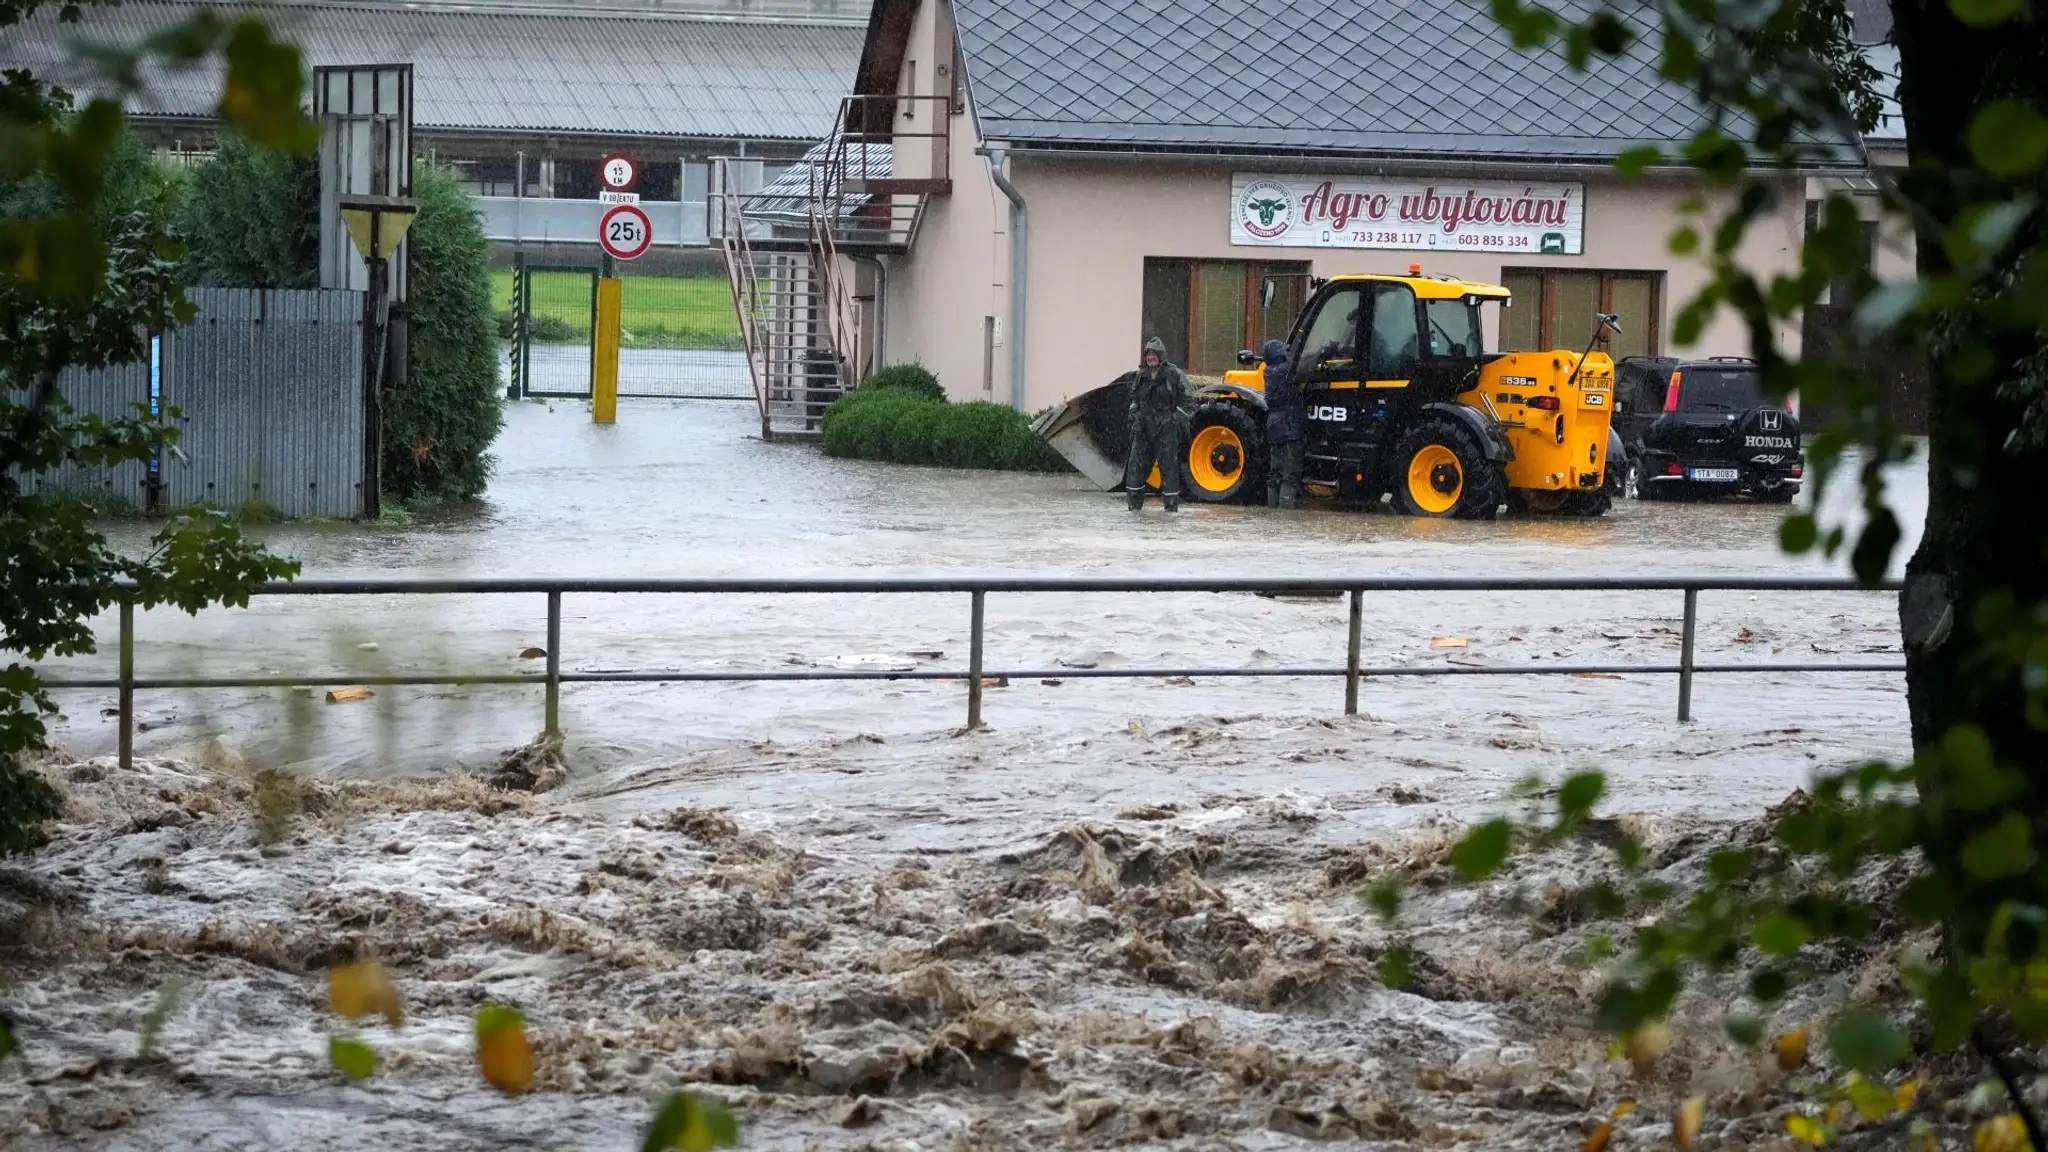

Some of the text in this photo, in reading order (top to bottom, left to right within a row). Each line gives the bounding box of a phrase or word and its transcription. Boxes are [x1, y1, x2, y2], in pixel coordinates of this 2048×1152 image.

[613, 167, 623, 176] 15
[1301, 180, 1573, 232] Agro ubytování
[1352, 232, 1373, 242] 733
[1376, 232, 1398, 243] 238
[1401, 233, 1422, 244] 117
[1458, 234, 1479, 245] 603
[1482, 234, 1504, 246] 835
[1507, 235, 1528, 246] 334
[1586, 394, 1603, 405] JCB
[1307, 405, 1347, 422] JCB
[1744, 436, 1793, 448] HONDA
[1697, 470, 1710, 478] 1TA
